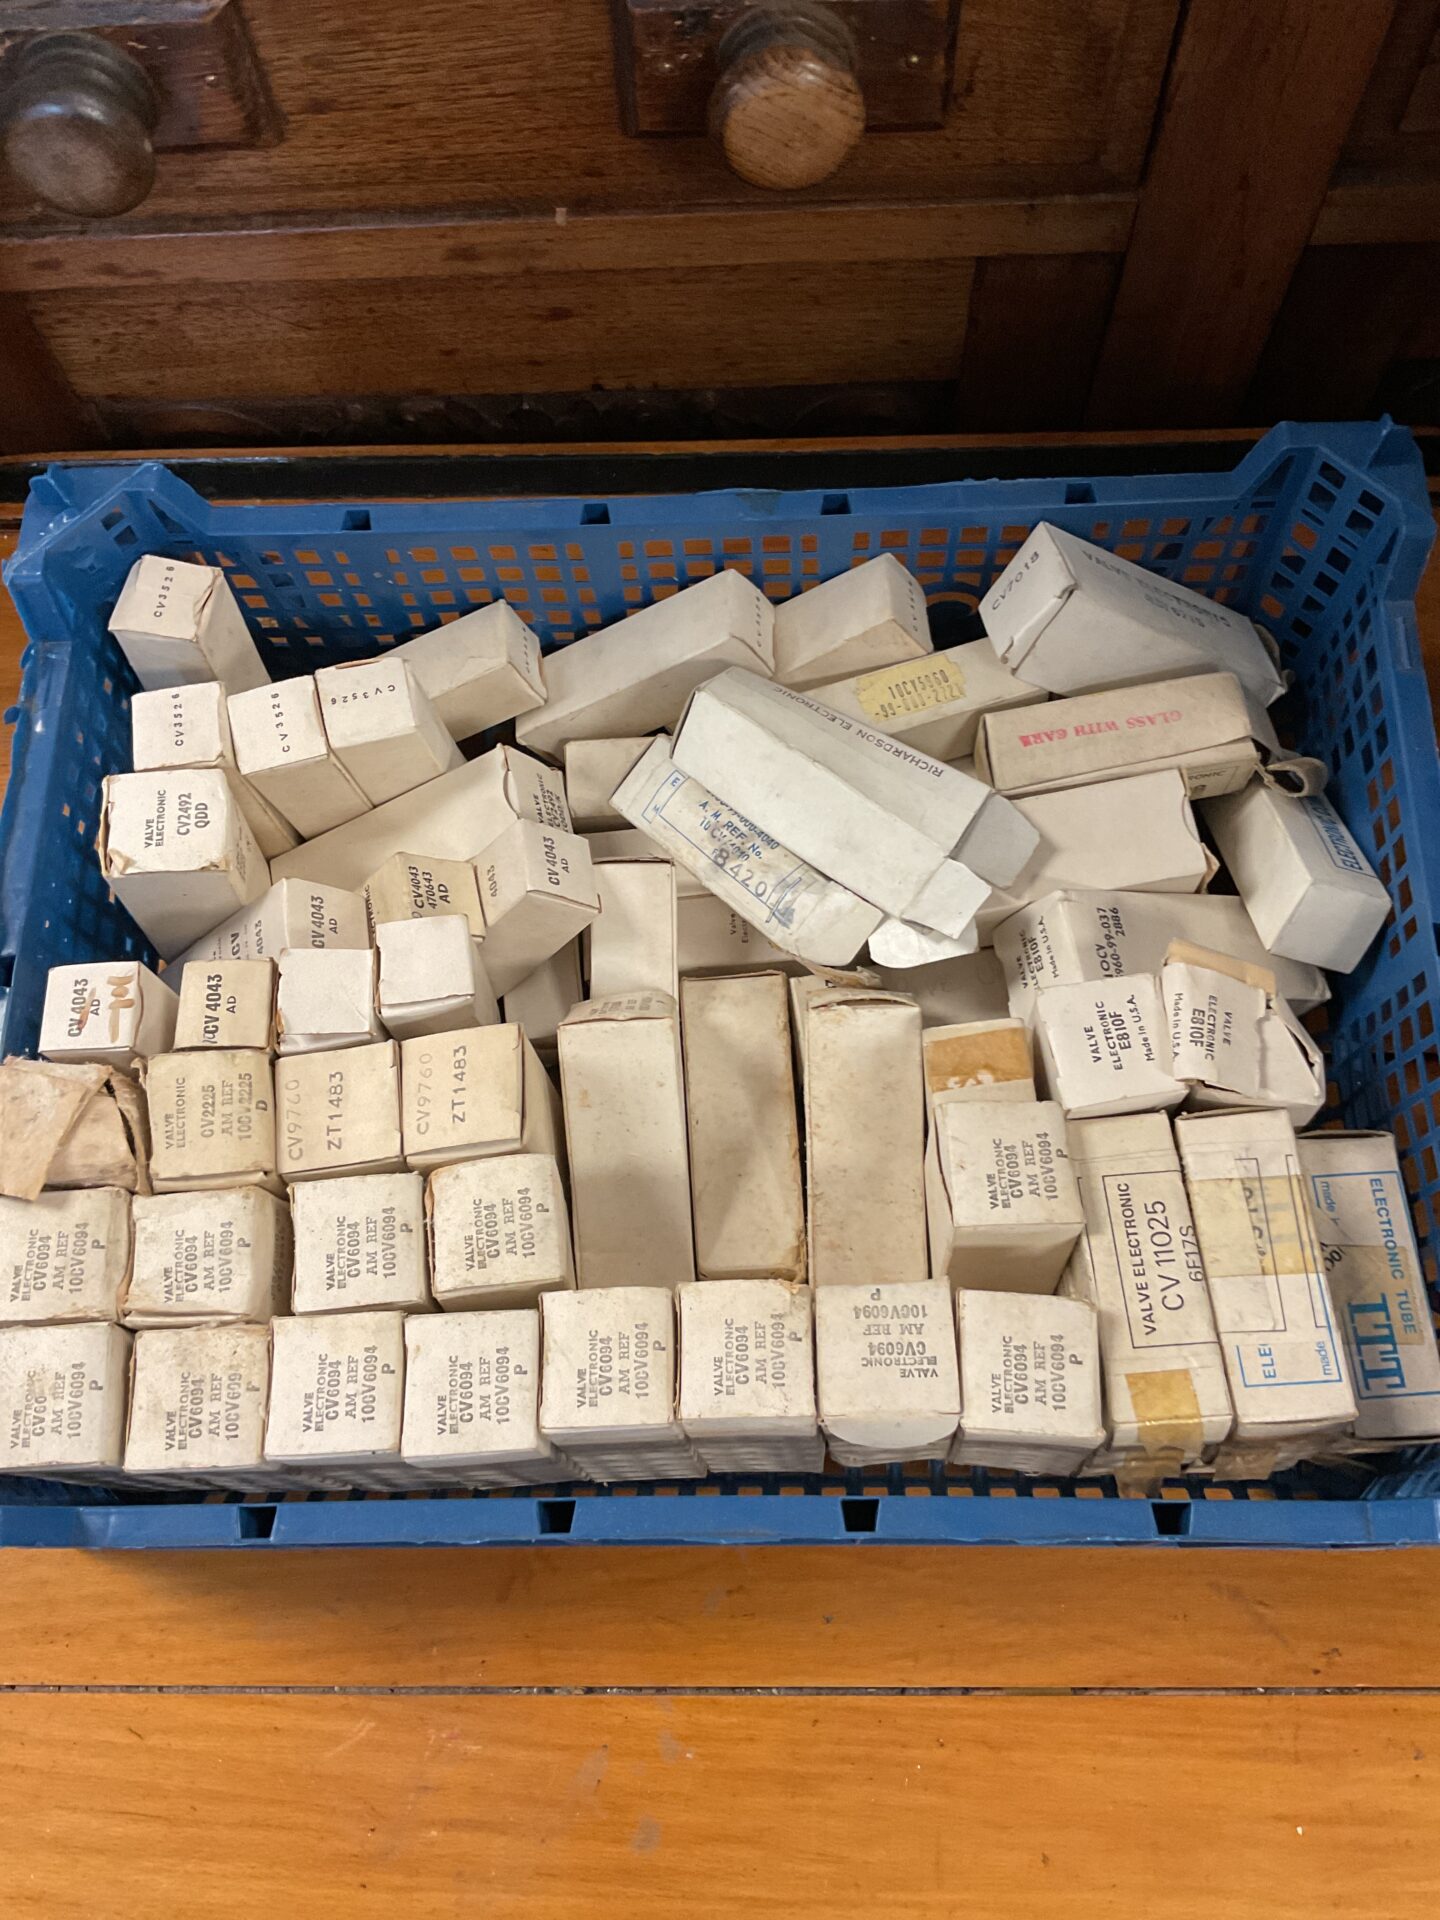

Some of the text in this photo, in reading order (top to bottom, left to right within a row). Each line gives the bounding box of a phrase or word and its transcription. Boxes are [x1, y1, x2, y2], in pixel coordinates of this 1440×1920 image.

[153, 565, 175, 618] CV3526
[171, 692, 184, 747] CV3526
[331, 684, 396, 705] CV3526
[773, 685, 853, 731] ELECTRONIC
[1125, 709, 1183, 729] GLASS
[271, 692, 290, 753] CV3526
[1074, 719, 1120, 737] WITH
[856, 728, 945, 778] RICHARDSON
[144, 818, 155, 848] VALVE
[155, 789, 167, 848] ELECTRONIC
[176, 792, 192, 836] CV2492
[194, 802, 210, 829] QDD
[560, 858, 570, 874] AD
[749, 842, 764, 860] No.
[424, 871, 438, 910] 470643
[438, 883, 451, 904] AD
[328, 917, 338, 934] AD
[1096, 907, 1124, 979] 960-99-037
[1111, 906, 1126, 937] 2886
[1015, 956, 1028, 989] VALVE
[1027, 936, 1044, 972] E810F
[90, 998, 101, 1016] AD
[225, 995, 237, 1014] AD
[1126, 994, 1142, 1024] U.S.A.
[1173, 992, 1184, 1017] Made
[1189, 1007, 1206, 1048] E810F
[1204, 994, 1219, 1062] ELECTRONIC
[1222, 1011, 1234, 1046] VALVE
[1083, 1025, 1102, 1063] VALVE
[1095, 1000, 1123, 1071] ELECTRONIC
[1109, 1010, 1132, 1052] E810F
[1143, 1037, 1155, 1062] Made
[221, 1080, 234, 1137] AM REF
[255, 1099, 268, 1112] D
[416, 1052, 434, 1136] CV9760
[452, 1044, 468, 1124] ZT1483
[165, 1112, 175, 1150] VALVE
[176, 1076, 187, 1149] ELECTRONIC
[200, 1084, 216, 1138] CV2225
[327, 1070, 344, 1151] ZT1483
[992, 1138, 1011, 1209] ELECTRONIC
[1004, 1144, 1023, 1199] CV6094
[1022, 1140, 1041, 1198] AM REF
[1036, 1131, 1059, 1200] 10CV6094
[1056, 1148, 1069, 1159] P
[536, 1202, 549, 1213] P
[986, 1173, 999, 1210] VALVE
[91, 1239, 106, 1249] P
[237, 1237, 250, 1248] P
[473, 1198, 487, 1269] ELECTRONIC
[484, 1203, 500, 1259] CV6094
[501, 1198, 518, 1255] AM REF
[517, 1187, 536, 1259] 10CV6094
[21, 1229, 39, 1301] ELECTRONIC
[33, 1235, 52, 1291] CV6094
[53, 1230, 69, 1290] AM REF
[69, 1222, 89, 1294] 10CV6094
[175, 1229, 185, 1302] ELECTRONIC
[184, 1235, 199, 1293] CV6094
[203, 1230, 216, 1290] AM REF
[218, 1221, 234, 1293] 10CV6094
[465, 1235, 475, 1272] VALVE
[1117, 1183, 1158, 1335] VALVE ELECTRONIC
[1179, 1225, 1205, 1282] 6F17S
[1370, 1177, 1418, 1335] ELECTRONIC TUBE
[10, 1265, 23, 1303] VALVE
[164, 1266, 173, 1304] VALVE
[870, 1288, 881, 1301] P
[787, 1331, 802, 1342] P
[853, 1304, 928, 1320] 10CV6094
[863, 1323, 925, 1336] AM REF
[381, 1364, 396, 1375] P
[513, 1364, 528, 1375] P
[589, 1329, 599, 1408] ELECTRONIC
[599, 1335, 613, 1396] CV6094
[618, 1332, 630, 1395] AM REF
[634, 1322, 650, 1399] 10CV6094
[652, 1339, 666, 1351] P
[725, 1318, 735, 1395] ELECTRONIC
[735, 1325, 749, 1385] CV6094
[754, 1321, 767, 1384] AM REF
[770, 1312, 787, 1389] 10CV6094
[861, 1355, 937, 1367] ELECTRONIC
[868, 1341, 926, 1356] CV6094
[1069, 1354, 1083, 1365] P
[1316, 1341, 1333, 1376] made
[314, 1353, 328, 1432] ELECTRONIC
[325, 1360, 342, 1421] CV6094
[345, 1355, 360, 1419] AM REF
[362, 1345, 378, 1423] 10CV6094
[449, 1355, 459, 1434] ELECTRONIC
[459, 1362, 474, 1423] CV6094
[479, 1357, 491, 1421] AM REF
[496, 1346, 510, 1425] 10CV6094
[576, 1368, 587, 1408] VALVE
[714, 1356, 723, 1396] VALVE
[900, 1367, 939, 1378] VALVE
[991, 1373, 1002, 1414] VALVE
[1003, 1335, 1014, 1414] ELECTRONIC
[1014, 1343, 1029, 1405] CV6094
[1033, 1341, 1047, 1406] AM REF
[1050, 1334, 1066, 1411] 10CV6094
[302, 1392, 314, 1433] VALVE
[437, 1395, 447, 1435] VALVE
